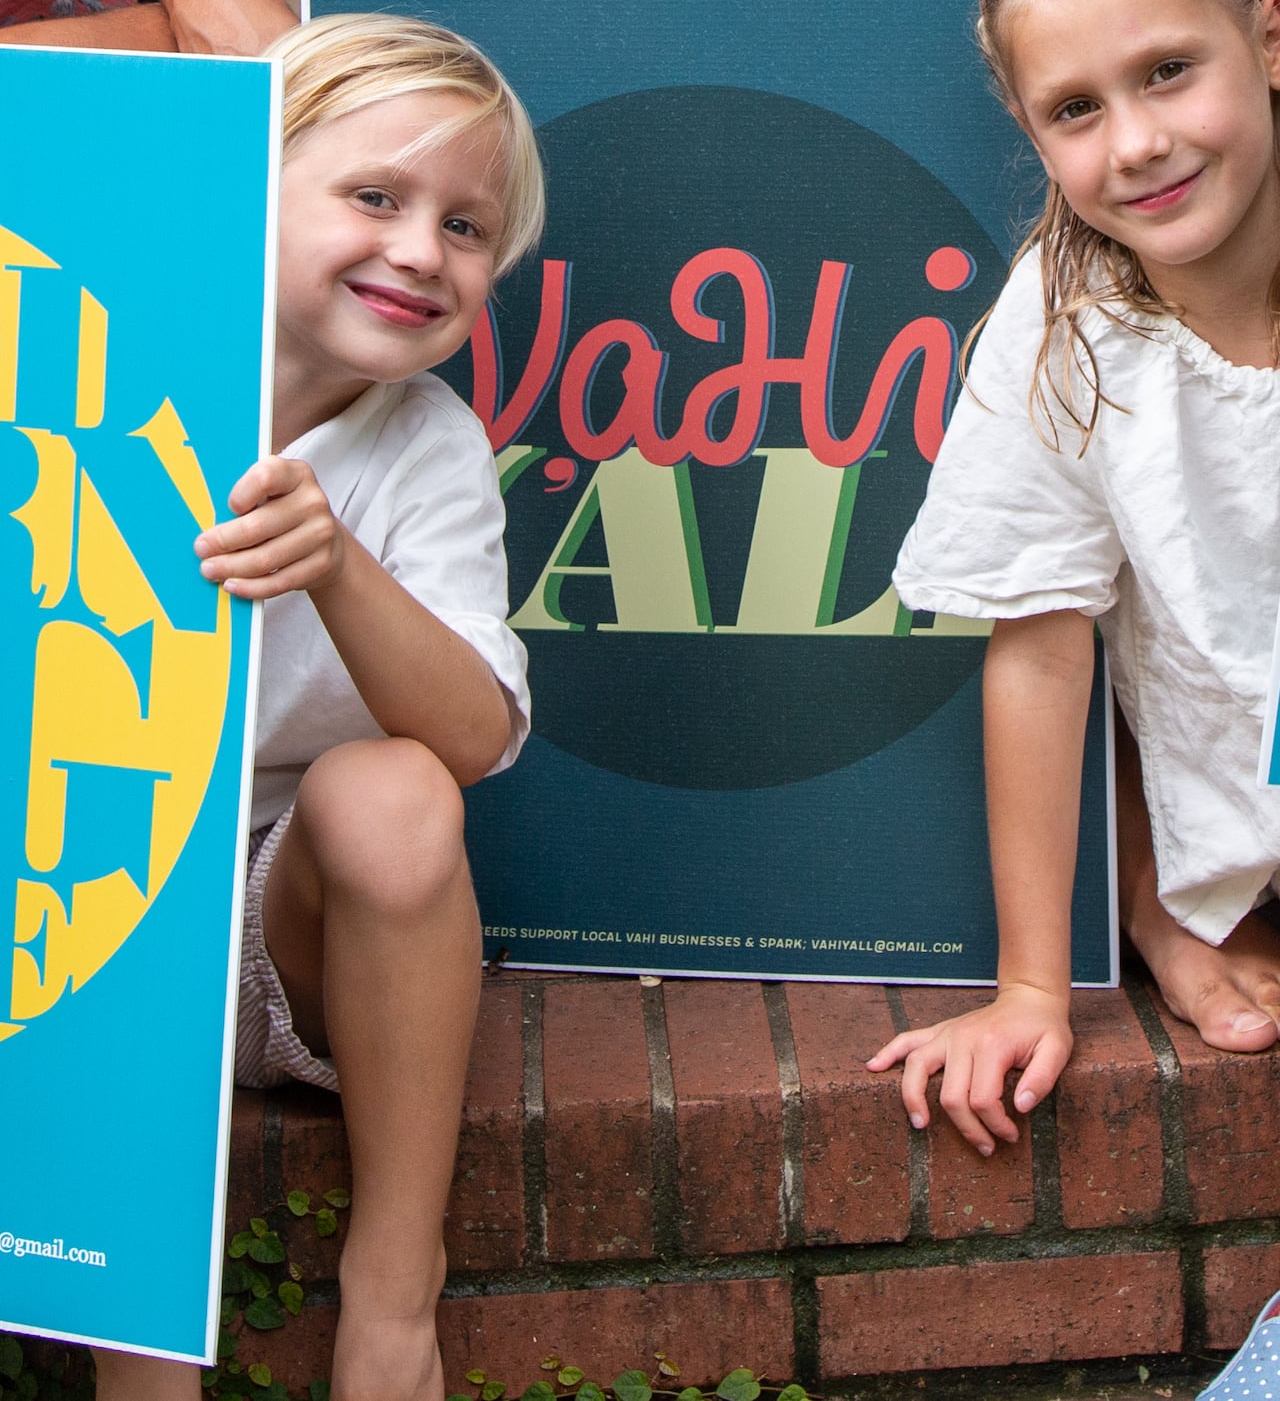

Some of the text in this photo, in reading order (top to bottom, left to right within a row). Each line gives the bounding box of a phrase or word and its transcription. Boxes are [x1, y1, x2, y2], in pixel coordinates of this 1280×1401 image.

[464, 246, 976, 468] VaHi
[480, 926, 963, 954] EEDS SUPPORT LOCAL VAHI BUSINESSES & SPARK; VAHIYALL@GMAIL.COM
